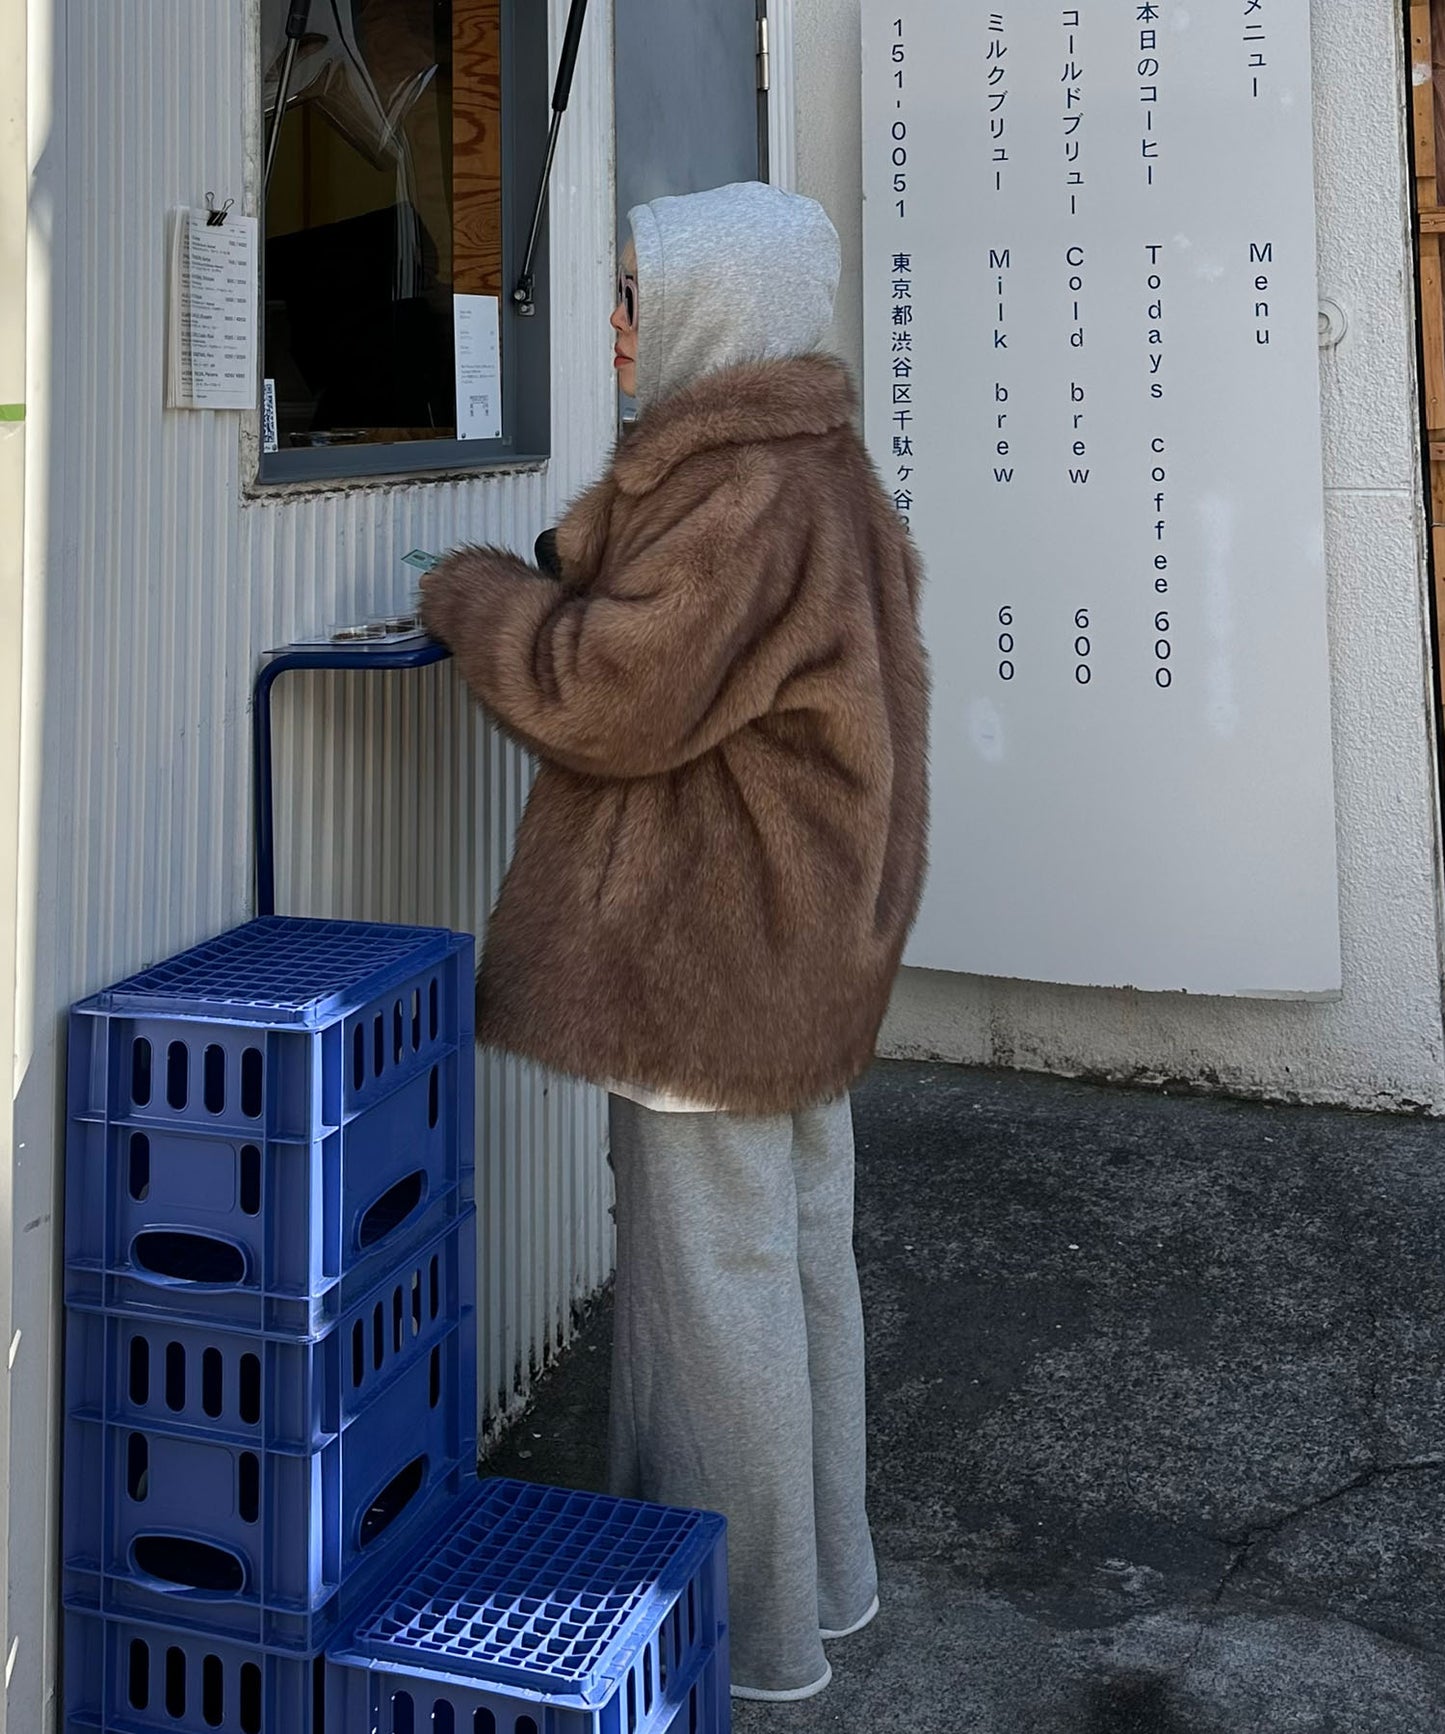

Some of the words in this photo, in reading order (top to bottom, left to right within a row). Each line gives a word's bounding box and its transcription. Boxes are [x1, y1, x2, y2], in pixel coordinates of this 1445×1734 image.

[1136, 1, 1159, 185] 本日のコーヒー
[1242, 0, 1267, 98] メニュー
[891, 18, 907, 218] 151-0051
[986, 13, 1009, 191] ミルクブリュー
[1060, 10, 1085, 215] コールドブリュー
[989, 249, 1010, 349] Milk
[1066, 246, 1084, 348] Cold
[1145, 245, 1163, 399] Todays
[1249, 242, 1272, 345] Menu
[993, 382, 1014, 483] brew
[1068, 382, 1090, 484] brew
[1151, 437, 1168, 594] coffee
[998, 605, 1015, 681] 600
[1074, 608, 1092, 685] 600
[1154, 611, 1172, 688] 600
